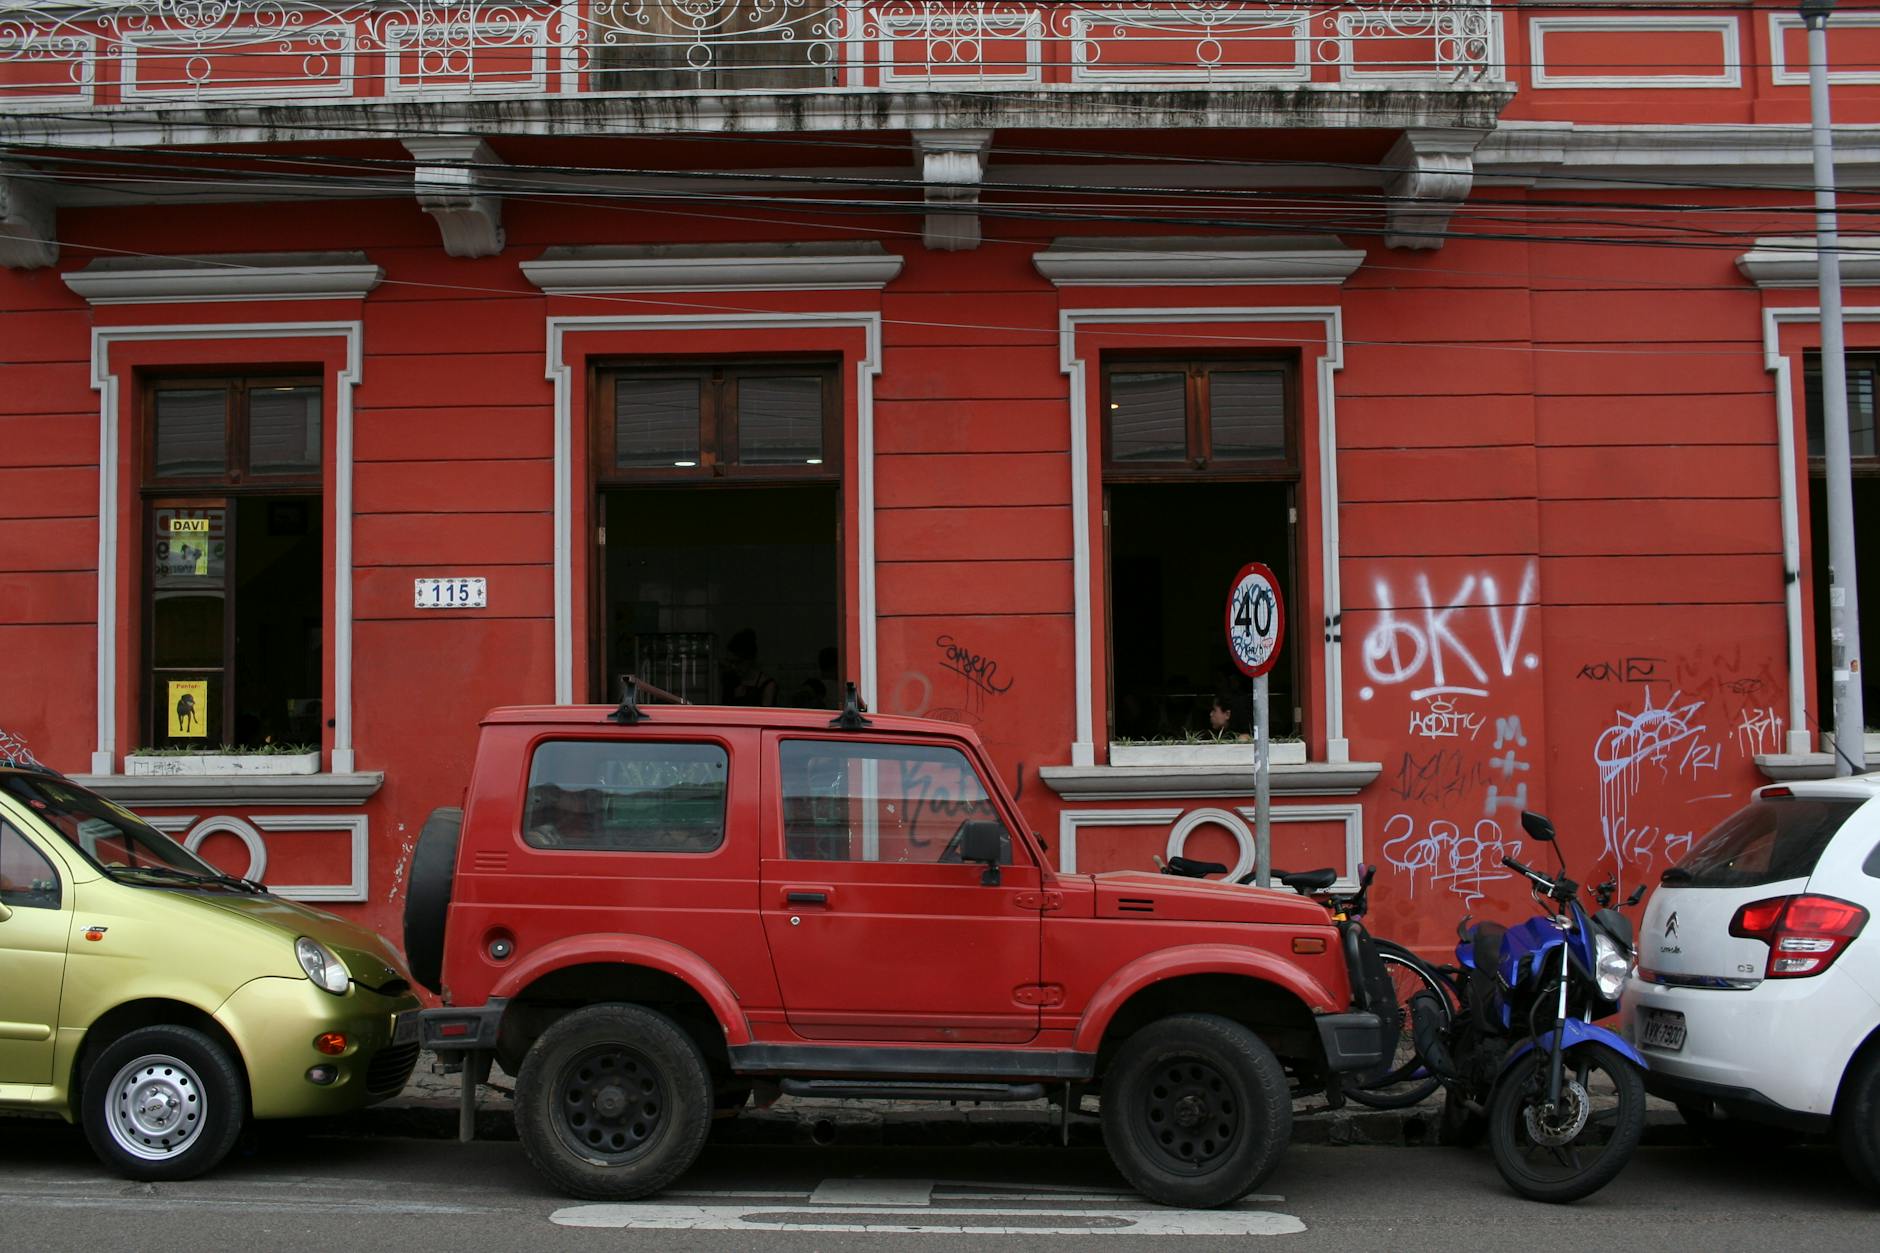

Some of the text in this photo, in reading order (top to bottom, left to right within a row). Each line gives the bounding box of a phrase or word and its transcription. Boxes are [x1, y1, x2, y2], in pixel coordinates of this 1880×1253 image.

[173, 521, 204, 531] DAVI
[432, 584, 469, 602] 115
[1234, 591, 1271, 637] 40
[1737, 964, 1755, 973] C3
